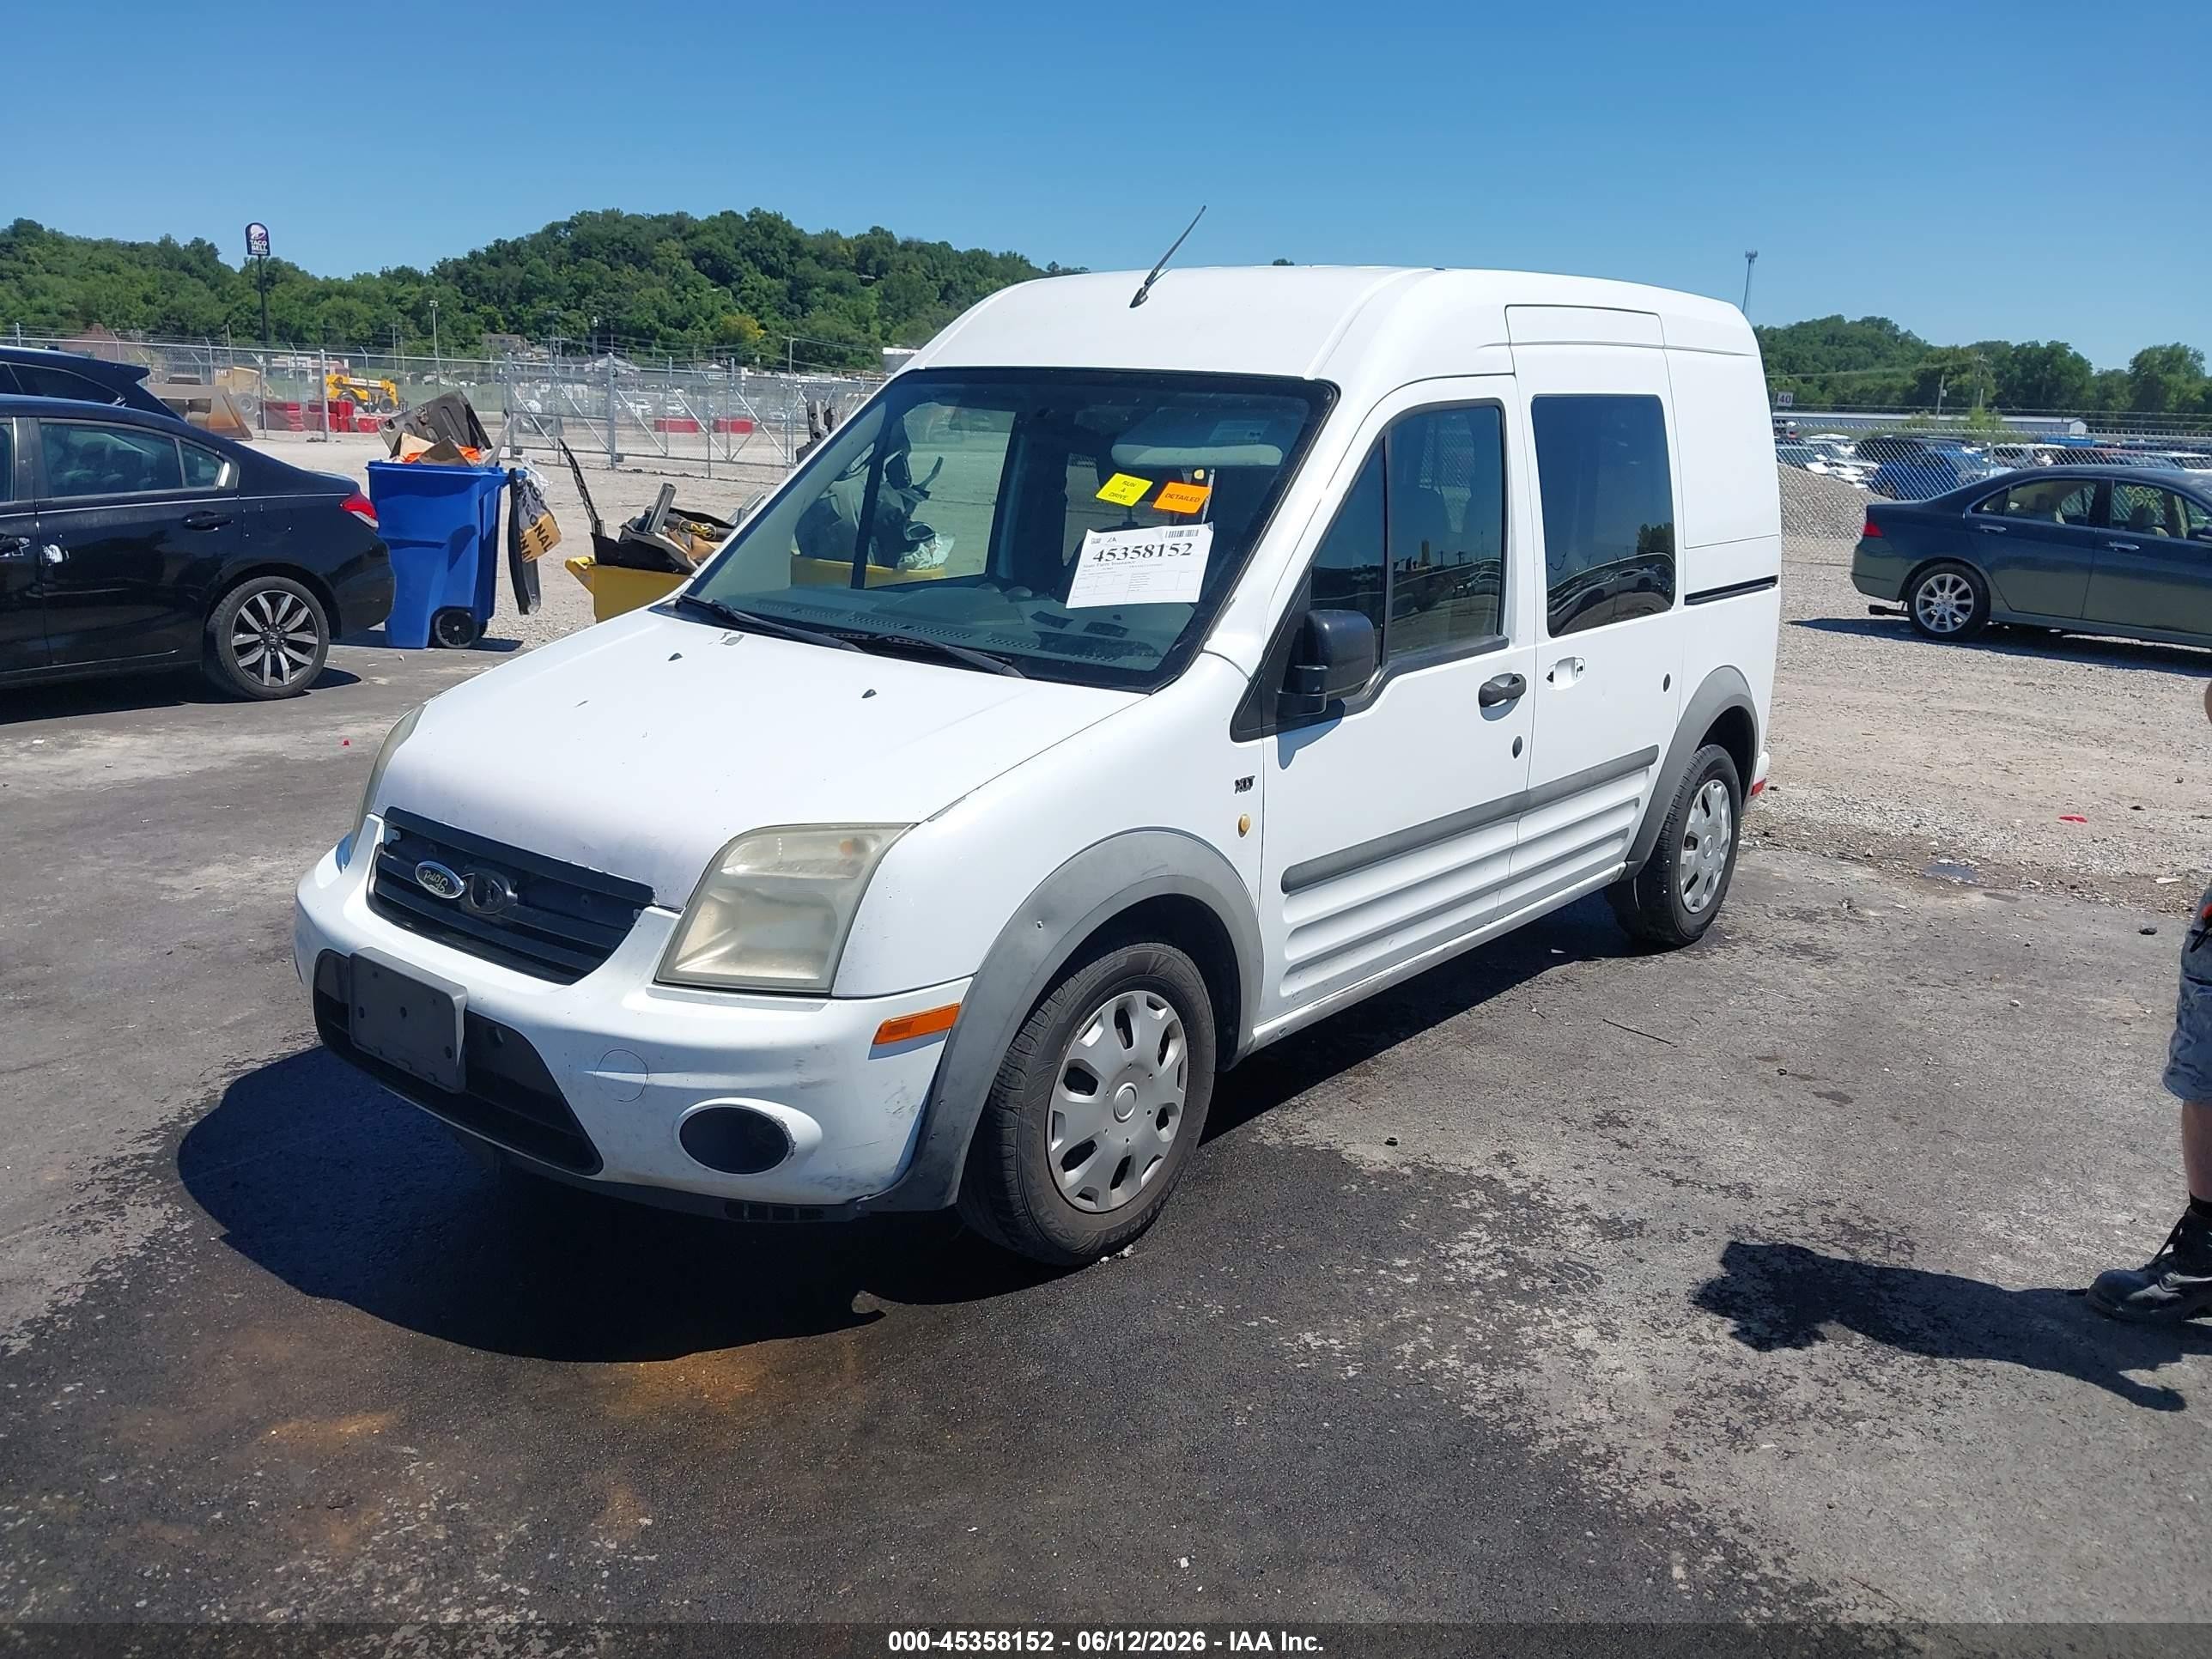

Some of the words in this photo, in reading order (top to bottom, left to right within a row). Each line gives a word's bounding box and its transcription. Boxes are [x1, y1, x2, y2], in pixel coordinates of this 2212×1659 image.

[1779, 395, 1791, 404] 40
[1164, 493, 1200, 503] DETAILED
[1092, 542, 1194, 562] 45358152
